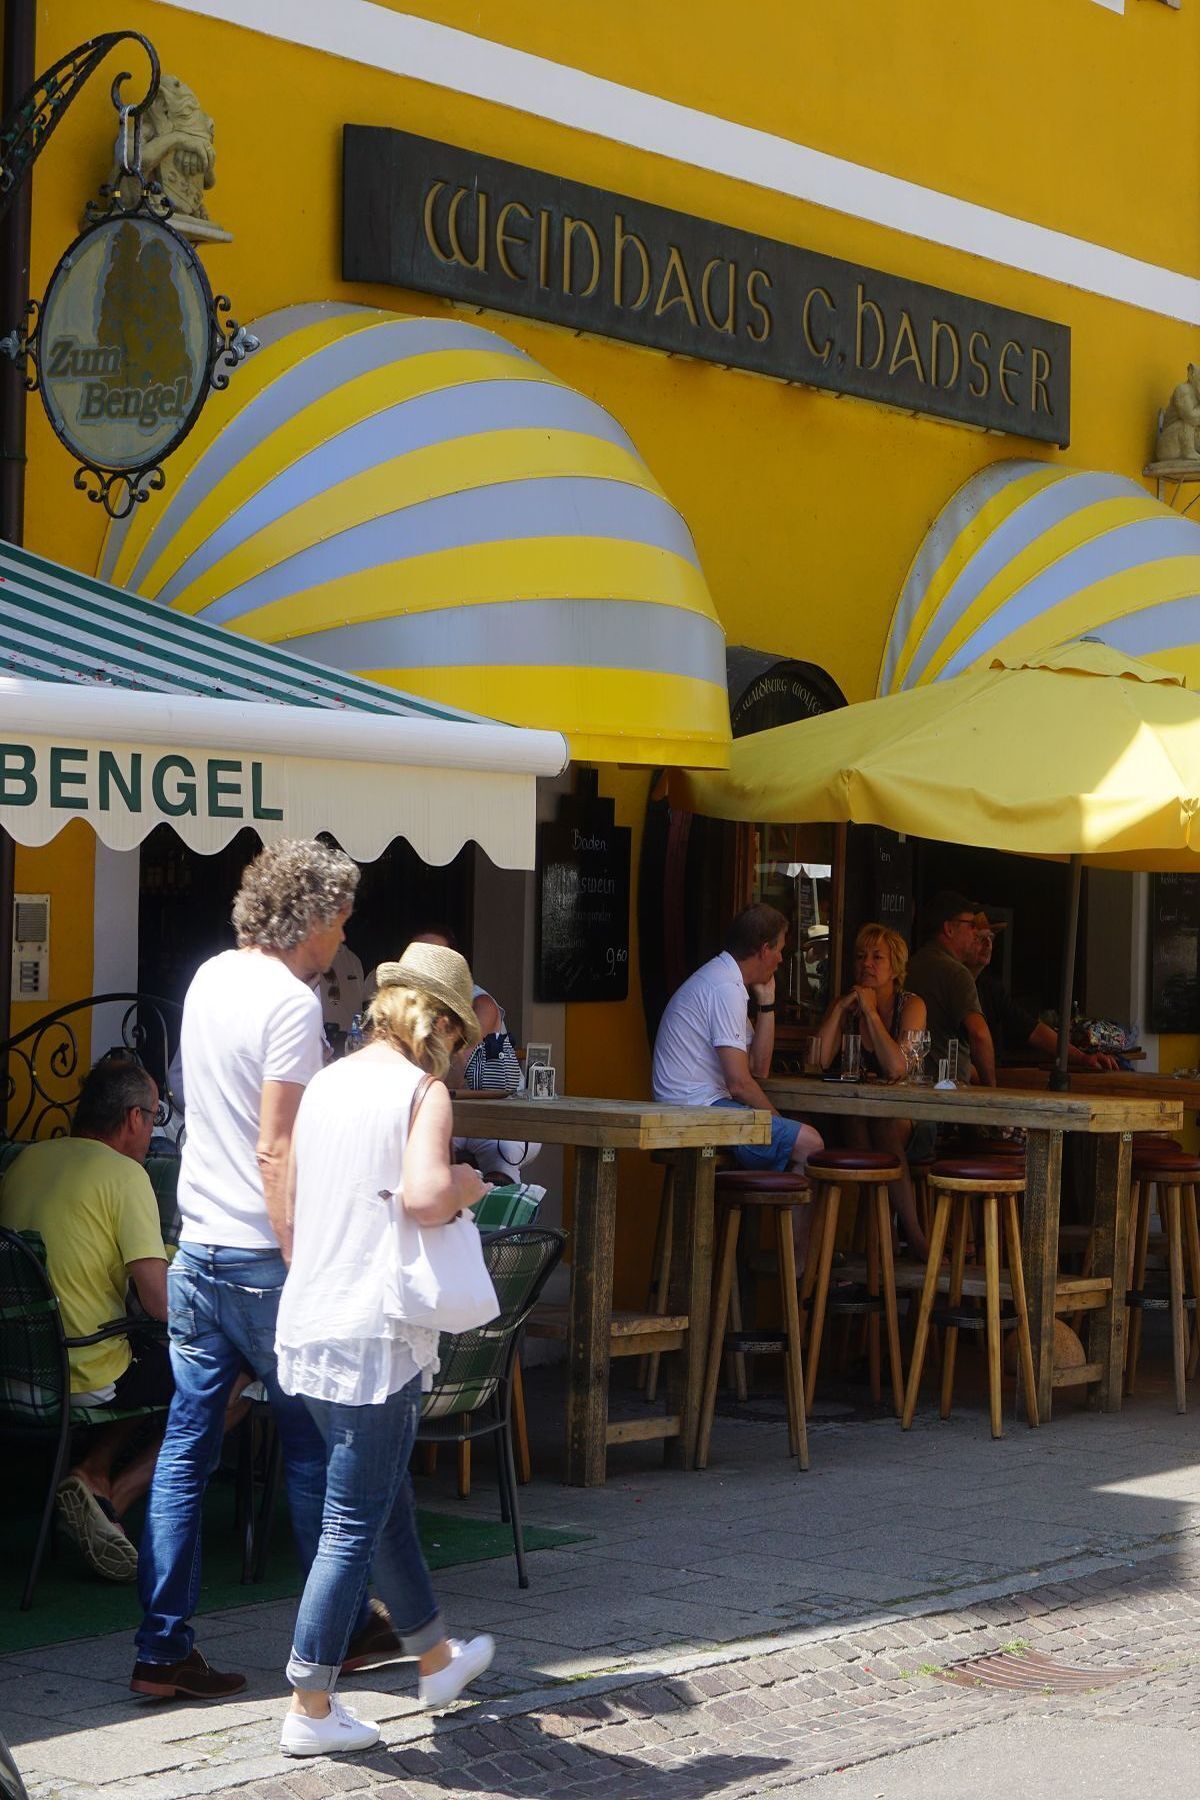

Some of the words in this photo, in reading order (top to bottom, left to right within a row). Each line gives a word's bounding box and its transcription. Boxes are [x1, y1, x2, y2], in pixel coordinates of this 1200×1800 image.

[47, 341, 121, 377] Zum
[80, 378, 187, 428] Bengel
[0, 743, 284, 821] BENGEL
